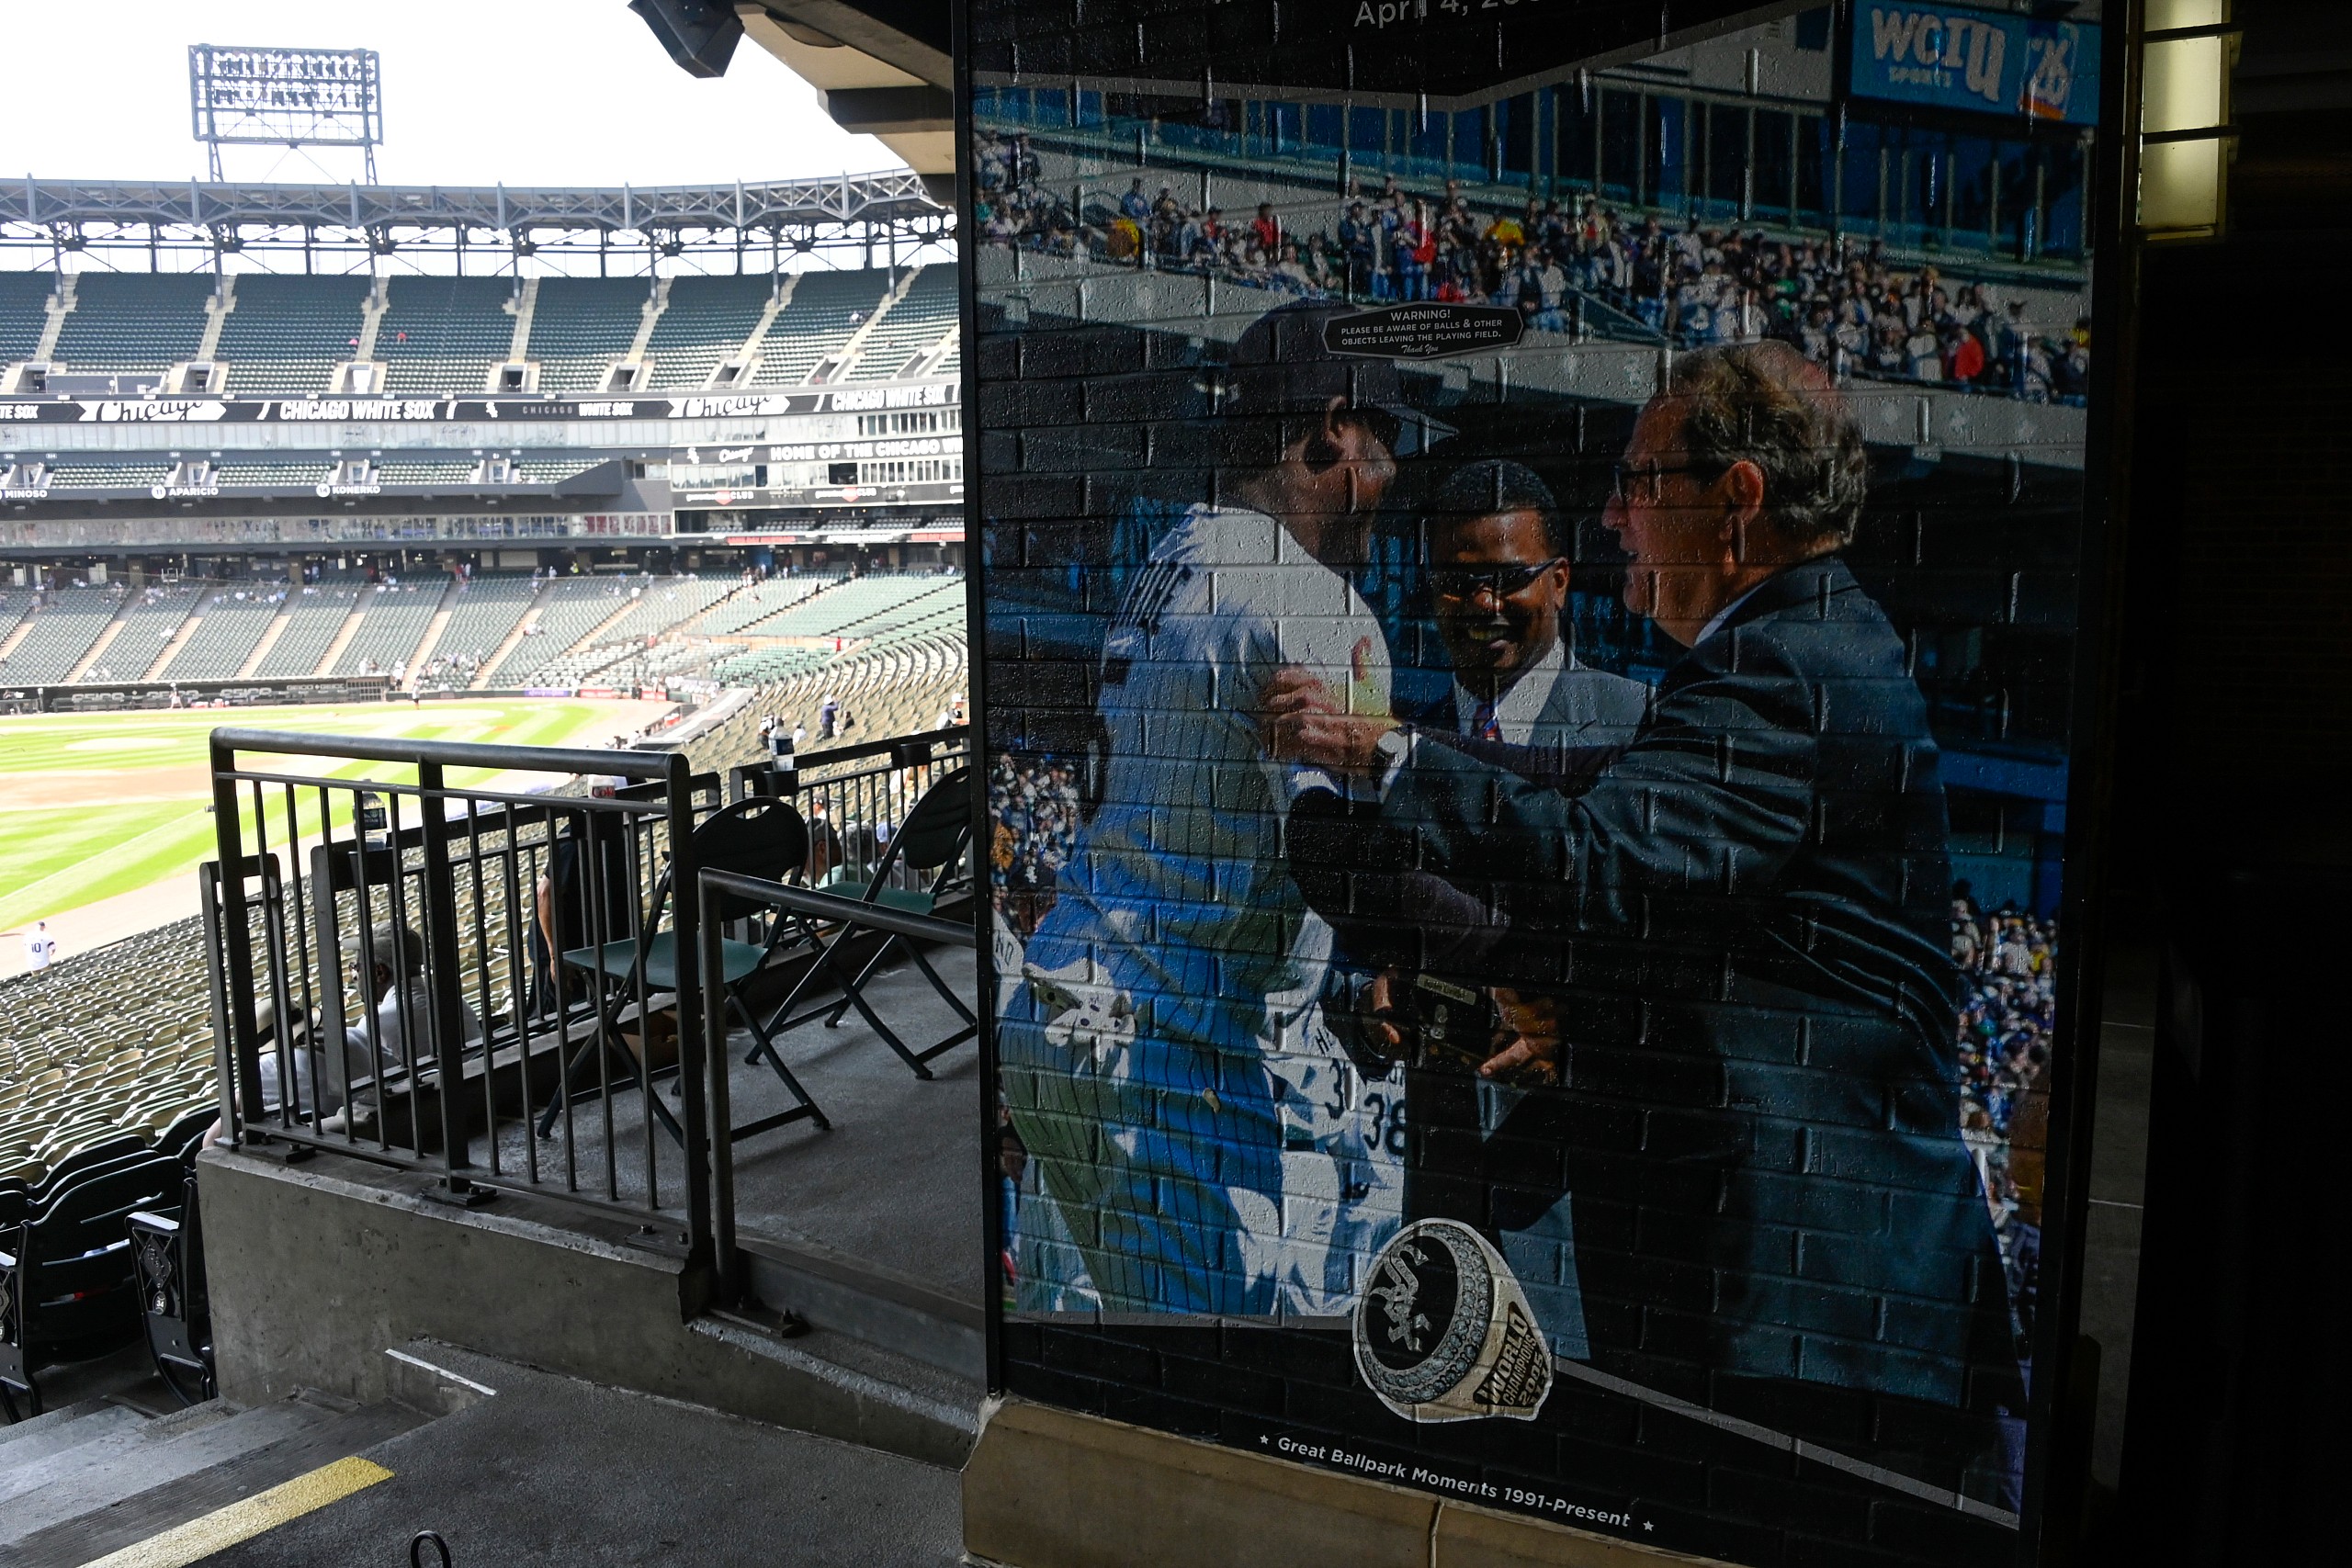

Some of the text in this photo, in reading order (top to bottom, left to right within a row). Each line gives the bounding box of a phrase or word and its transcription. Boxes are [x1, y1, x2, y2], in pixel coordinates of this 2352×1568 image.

[1871, 8, 2007, 102] WCIU
[1390, 309, 1451, 321] WARNING!
[1341, 326, 1370, 335] PLEASE
[1374, 325, 1383, 333] BE
[1419, 322, 1430, 331] OF
[1434, 321, 1459, 330] BALLS
[1463, 318, 1471, 329] &
[1474, 319, 1502, 328] OTHER
[1341, 330, 1501, 345] OBJECTS LEAVING THE PLAYING FIELD.
[1401, 344, 1439, 354] Thank You
[14, 405, 39, 419] SOX
[279, 400, 436, 420] CHICAGO WHITE SOX
[523, 402, 634, 416] CHICAGO WHITE SOX
[771, 446, 815, 461] HOME
[818, 445, 841, 459] OF
[844, 443, 873, 458] THE
[876, 439, 940, 457] CHICAGO
[5, 489, 48, 499] MINOSO
[168, 487, 219, 496] APARICIO
[332, 485, 381, 494] KONERKO
[31, 942, 41, 953] 10
[1363, 1092, 1406, 1155] 38
[156, 1300, 164, 1308] 34
[1476, 1312, 1530, 1404] WORLD
[1501, 1334, 1537, 1405] CHAMPIONS
[1517, 1351, 1544, 1405] 2005
[1278, 1436, 1632, 1528] Great Ballpark Moments 1991-Present
